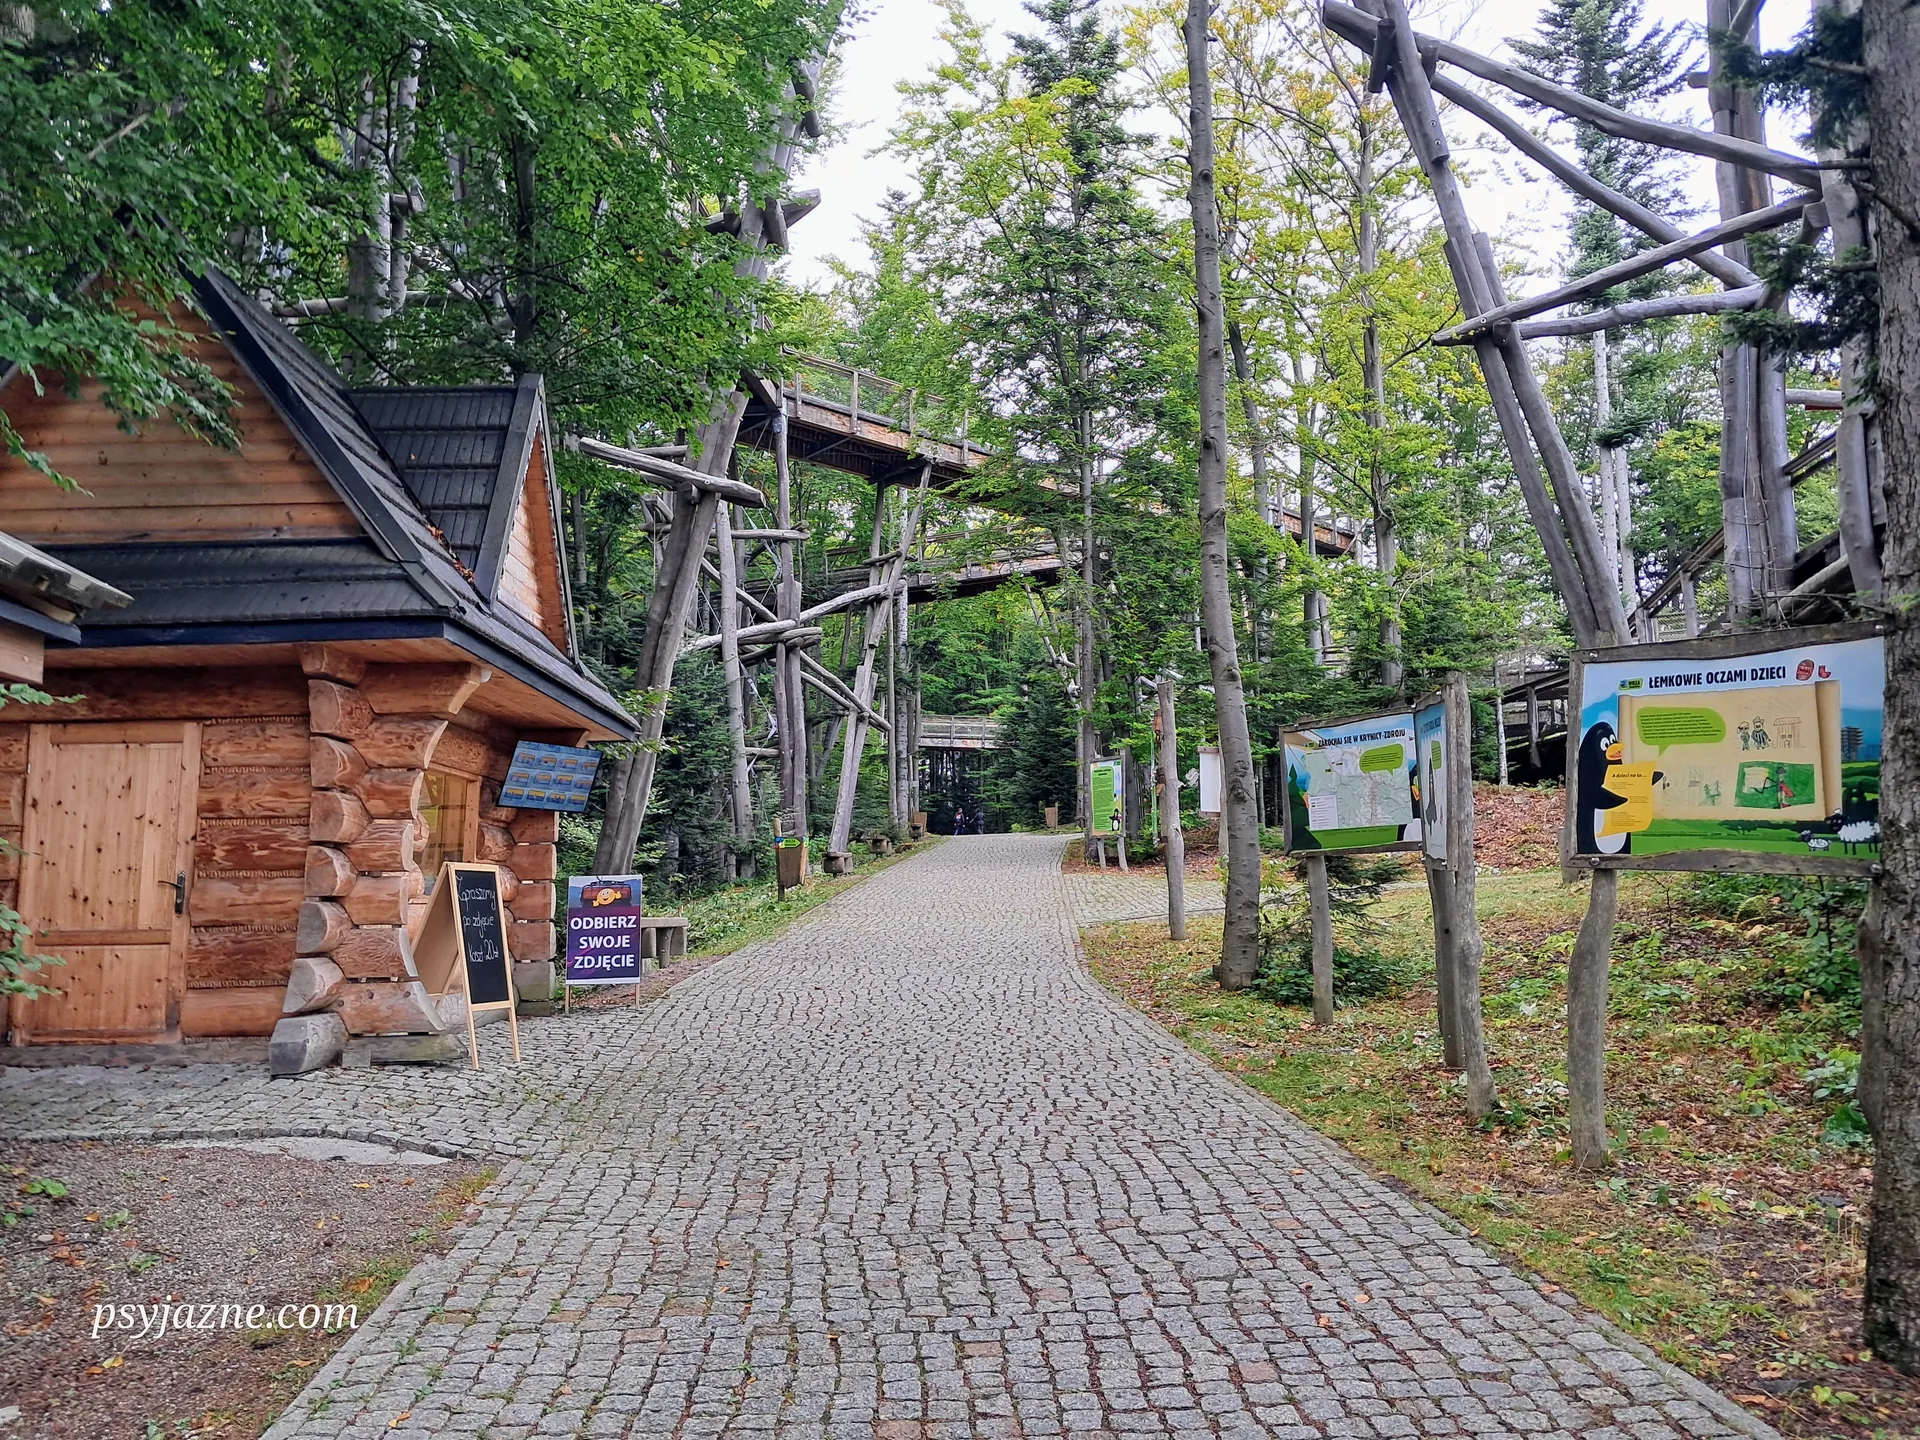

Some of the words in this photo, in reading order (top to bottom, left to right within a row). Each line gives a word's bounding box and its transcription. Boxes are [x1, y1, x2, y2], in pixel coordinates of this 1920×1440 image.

[1648, 672, 1702, 689] ŁEMKOWIE
[1706, 669, 1747, 685] OCZAMI
[1751, 665, 1786, 681] DZIECI
[1318, 737, 1343, 747] ZAKOCHAJ
[1359, 728, 1406, 742] KRYNICY-ZDROJU
[462, 915, 471, 932] po
[570, 915, 637, 930] ODBIERZ
[579, 935, 631, 949] SWOJE
[573, 954, 635, 971] ZDJĘCIE
